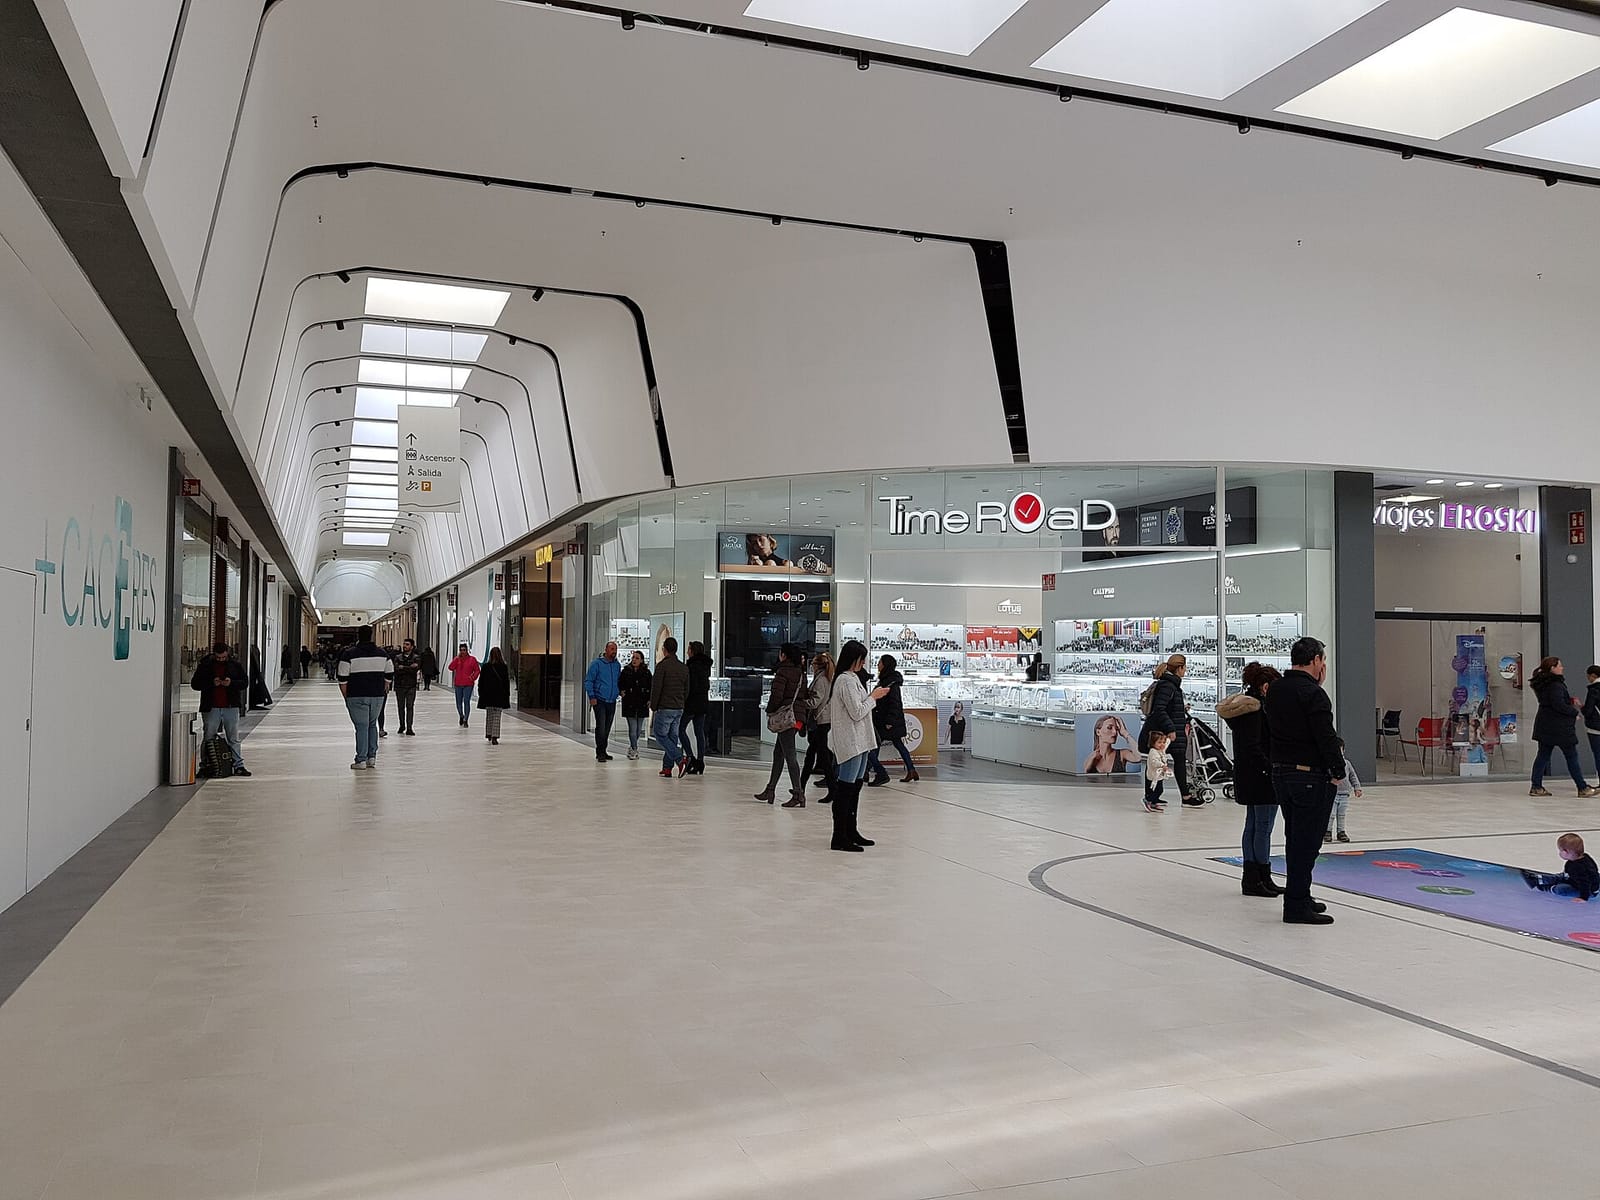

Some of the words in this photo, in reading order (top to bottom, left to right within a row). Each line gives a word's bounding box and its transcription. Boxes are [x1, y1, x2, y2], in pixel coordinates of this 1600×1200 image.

[419, 453, 456, 463] Ascensor
[417, 468, 442, 477] Salida
[878, 495, 971, 535] Time
[1438, 501, 1537, 535] EROSKI
[1092, 587, 1115, 595] CALYPSO
[890, 602, 916, 611] LOTUS
[997, 604, 1022, 612] LOTUS
